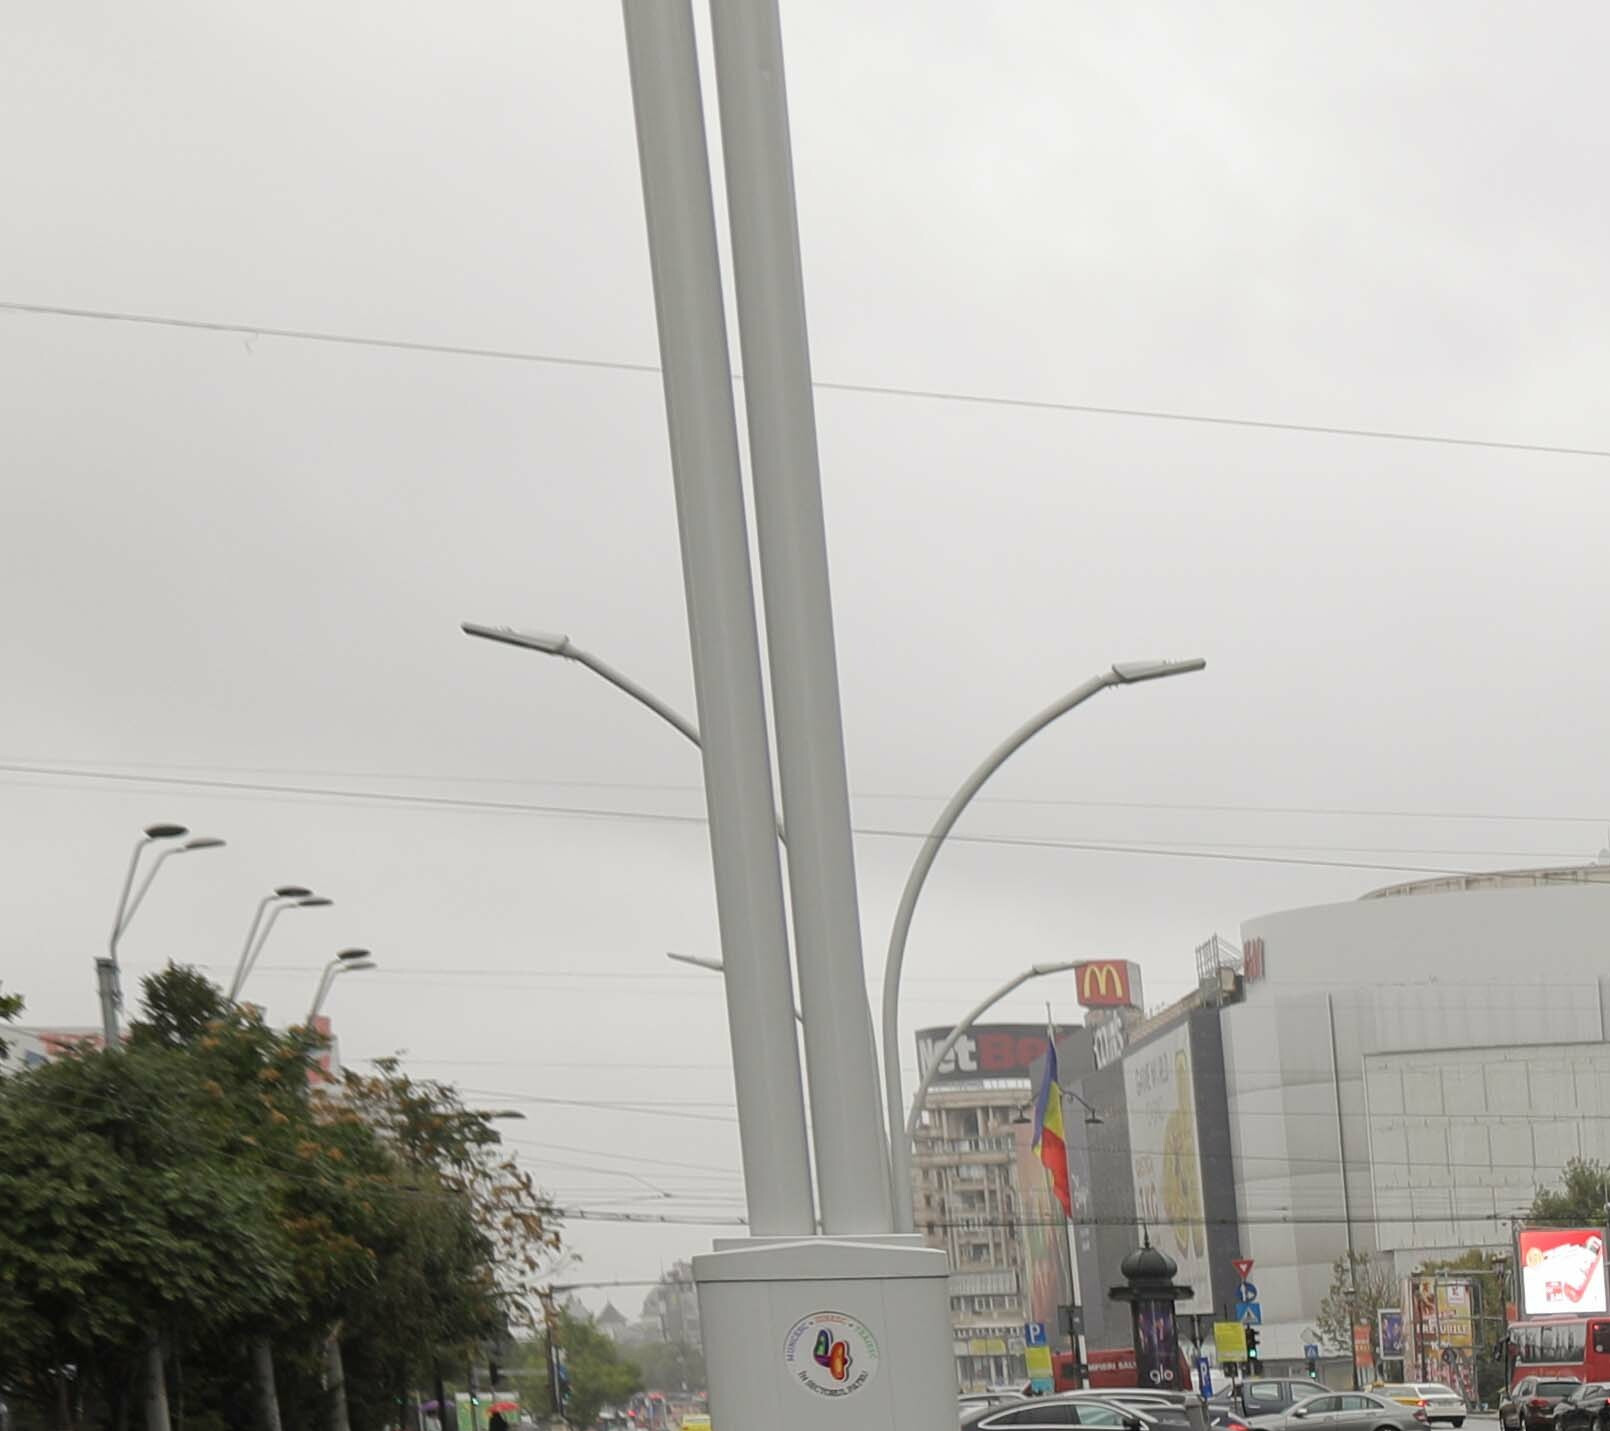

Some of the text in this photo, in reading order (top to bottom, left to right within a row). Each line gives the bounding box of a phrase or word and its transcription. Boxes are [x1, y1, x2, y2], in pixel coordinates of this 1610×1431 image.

[1029, 1324, 1040, 1343] P
[1150, 1363, 1173, 1384] glo
[1200, 1363, 1208, 1384] P
